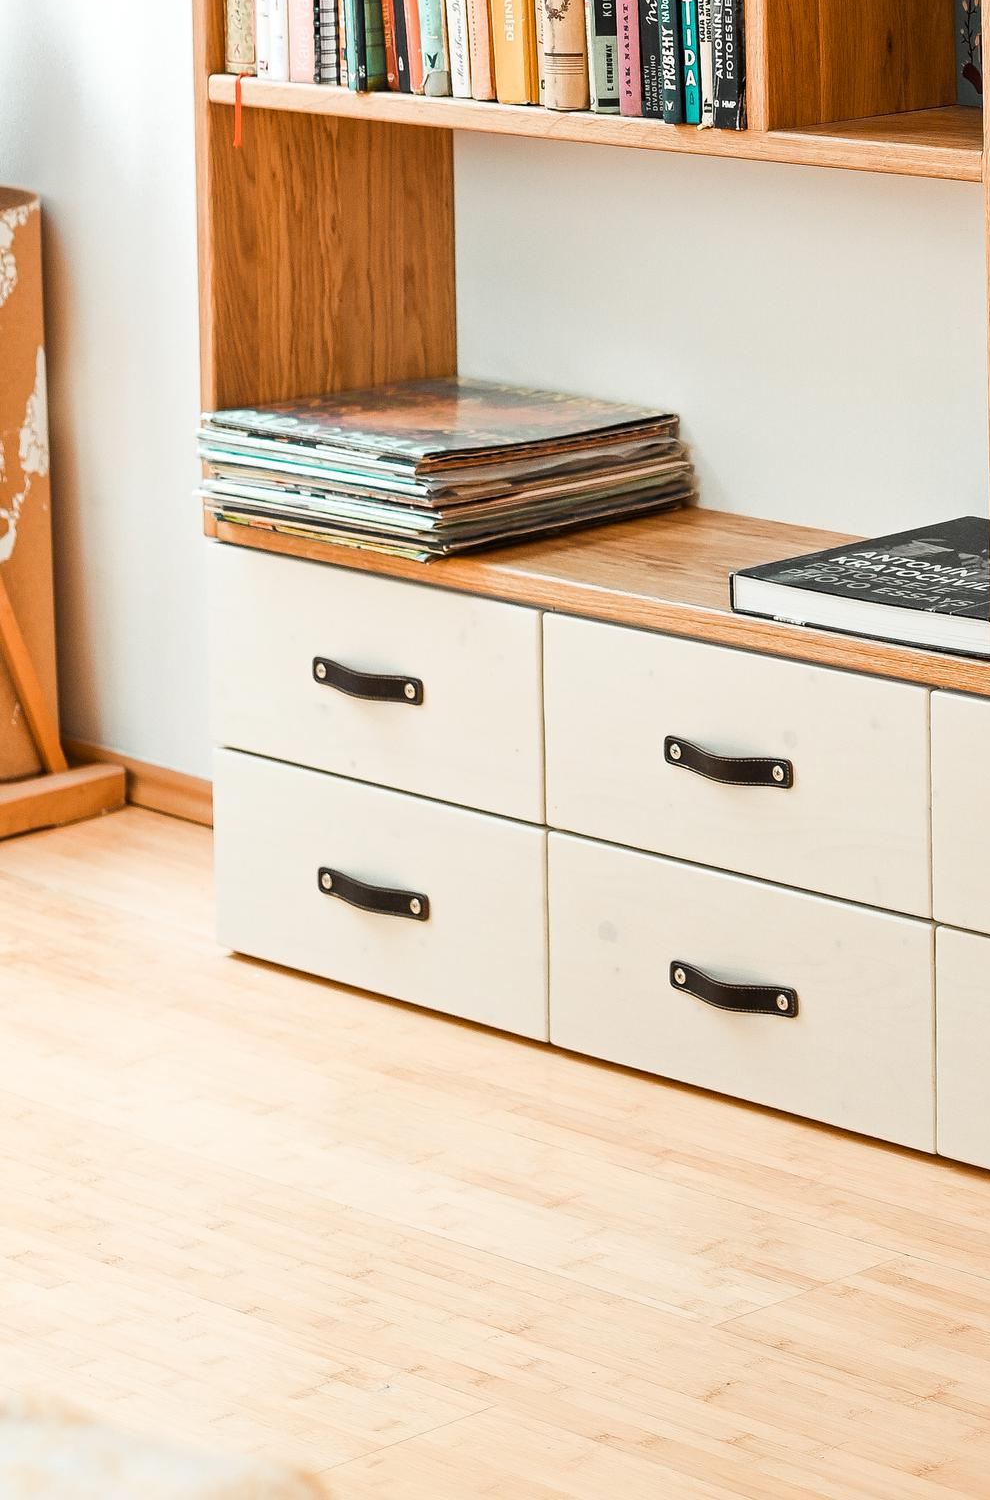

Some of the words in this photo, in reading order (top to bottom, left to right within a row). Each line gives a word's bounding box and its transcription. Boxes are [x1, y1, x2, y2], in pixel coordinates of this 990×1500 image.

[710, 13, 723, 79] ANTONÍN
[723, 0, 735, 80] FOTOESEJE
[780, 569, 871, 589] PHOTO
[872, 587, 976, 607] ESSAYS
[853, 551, 979, 577] ANTONÍN
